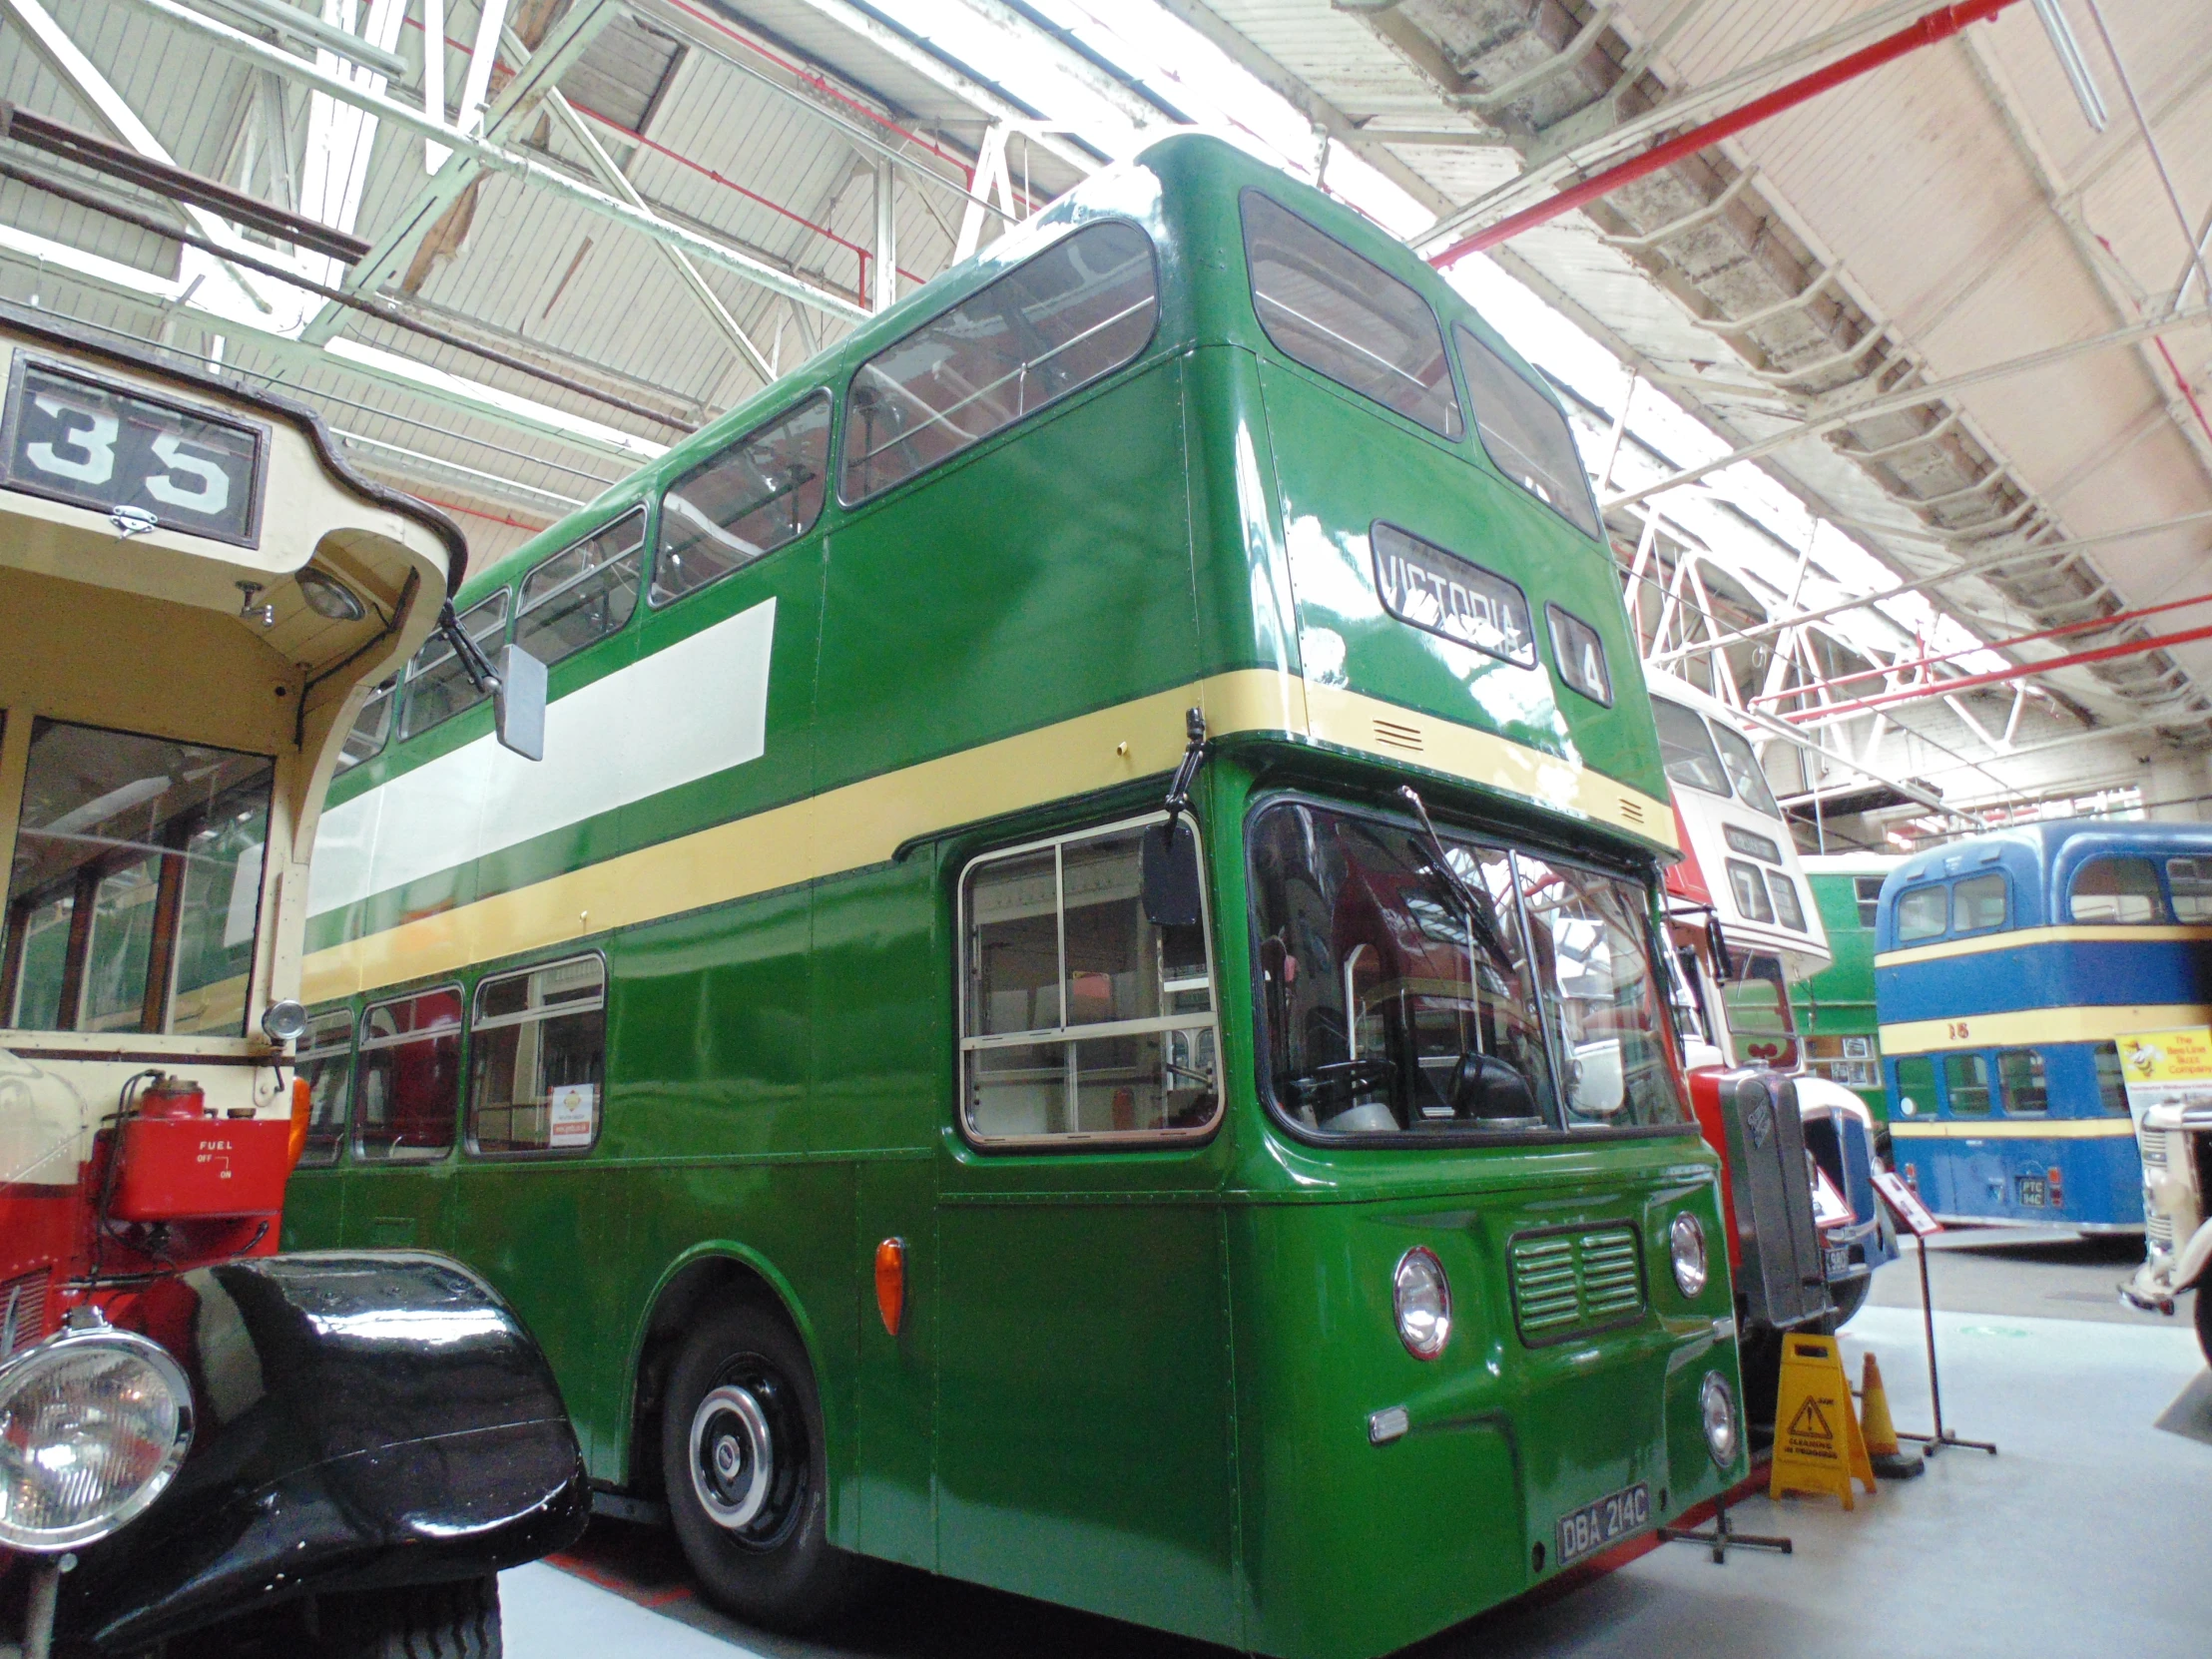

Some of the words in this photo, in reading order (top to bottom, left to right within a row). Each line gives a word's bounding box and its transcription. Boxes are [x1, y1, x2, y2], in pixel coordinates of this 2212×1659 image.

[27, 395, 230, 515] 35
[1377, 552, 1520, 657] VICTORIA
[1582, 643, 1605, 701] 4
[2168, 1065, 2212, 1076] Company
[200, 1141, 233, 1150] FUEL
[197, 1154, 213, 1163] OFF
[220, 1170, 232, 1179] ON
[2022, 1181, 2042, 1193] PTC
[1788, 1437, 1833, 1450] CLEANING
[1562, 1508, 1602, 1558] DBA
[1606, 1487, 1648, 1536] 214C
